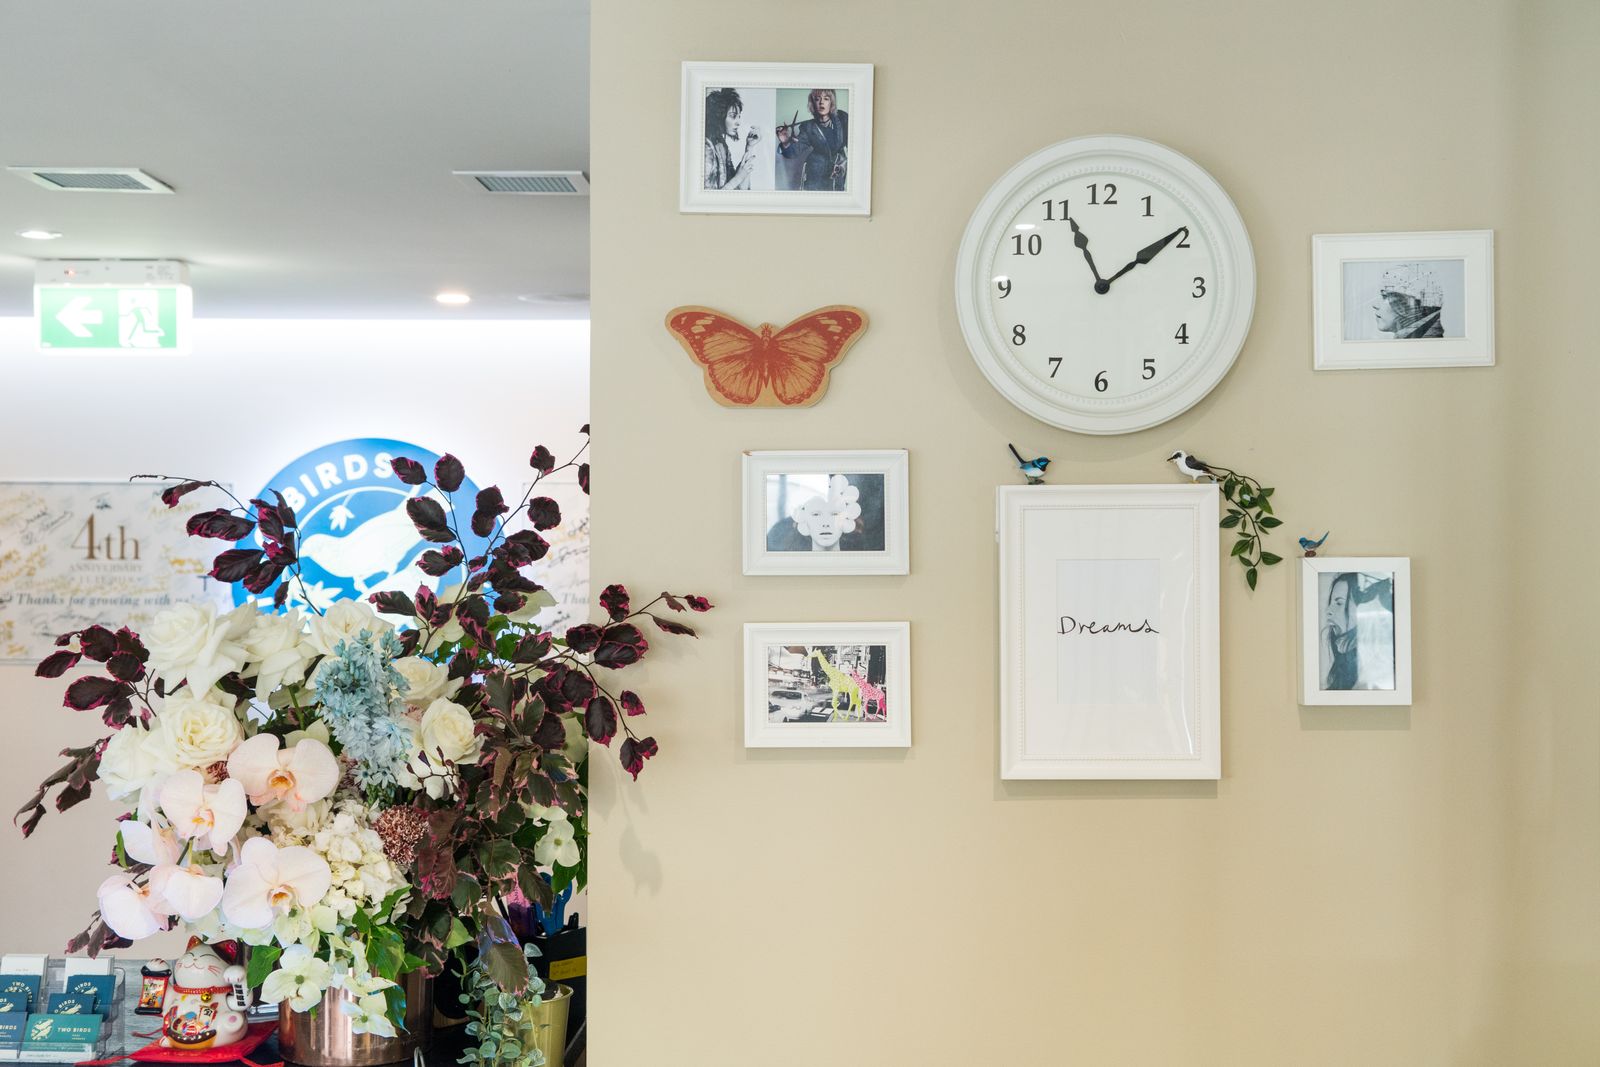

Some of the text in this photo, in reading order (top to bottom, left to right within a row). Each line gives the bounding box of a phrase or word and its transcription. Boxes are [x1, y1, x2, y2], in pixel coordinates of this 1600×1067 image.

[1086, 183, 1118, 205] 12
[1041, 199, 1071, 221] 11
[1141, 195, 1155, 217] 1
[1011, 234, 1042, 256] 10
[1175, 226, 1191, 249] 2
[997, 279, 1012, 299] 9
[1191, 276, 1207, 299] 3
[1011, 324, 1027, 346] 8
[1174, 323, 1190, 345] 4
[1048, 357, 1063, 378] 7
[1141, 358, 1156, 380] 5
[1094, 370, 1109, 393] 6
[281, 452, 396, 516] BIRDS
[70, 513, 141, 561] 4th
[16, 592, 65, 605] Thanks
[68, 593, 88, 610] for
[87, 596, 139, 610] growing
[144, 593, 171, 605] with
[1057, 615, 1160, 635] Dreams
